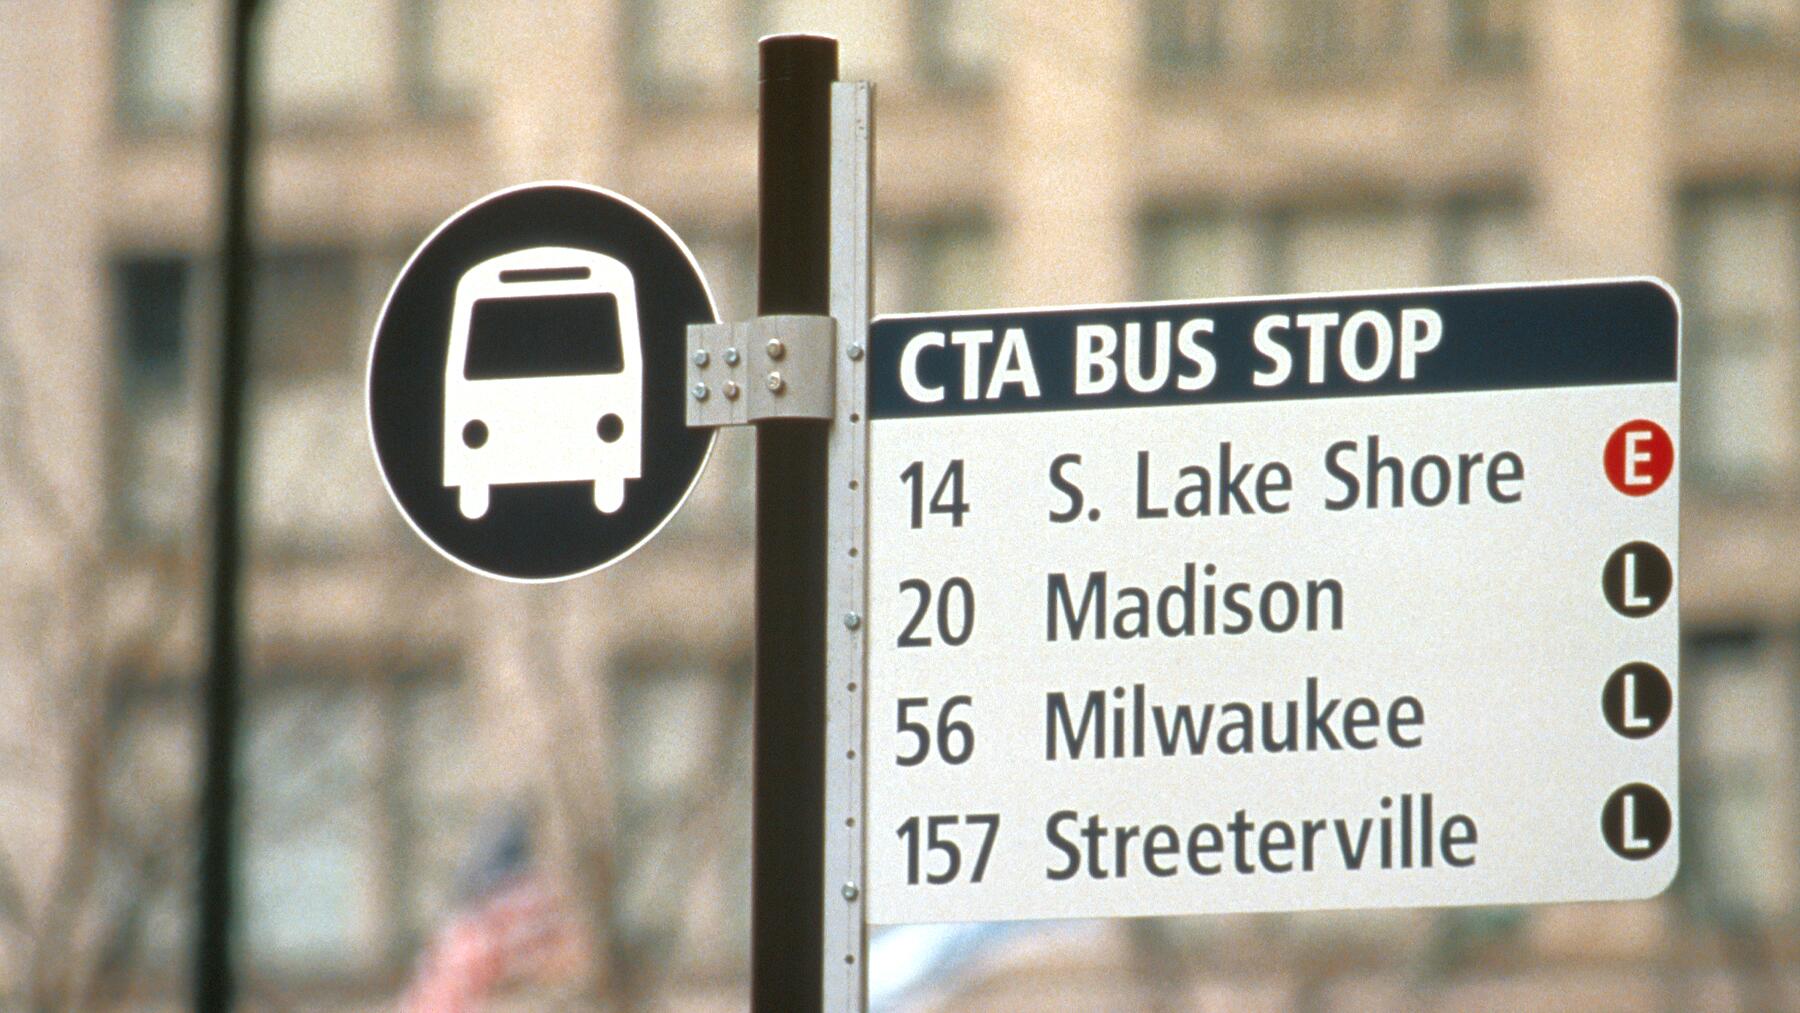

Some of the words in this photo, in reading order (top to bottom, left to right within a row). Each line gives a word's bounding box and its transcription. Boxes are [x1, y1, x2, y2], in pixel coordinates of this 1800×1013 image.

[899, 327, 1041, 404] CTA
[1074, 317, 1217, 396] BUS
[1252, 307, 1444, 388] STOP
[900, 460, 969, 529] 14
[1050, 454, 1100, 523] S.
[1137, 442, 1292, 519] Lake
[1325, 435, 1524, 511] Shore
[1623, 429, 1654, 487] E
[897, 577, 974, 647] 20
[1047, 563, 1343, 641] Madison
[1623, 551, 1652, 608] L
[896, 695, 974, 766] 56
[1046, 677, 1424, 760] Milwaukee
[1623, 672, 1652, 730] L
[897, 814, 999, 885] 157
[1046, 793, 1477, 880] Streeterville
[1623, 793, 1651, 851] L
